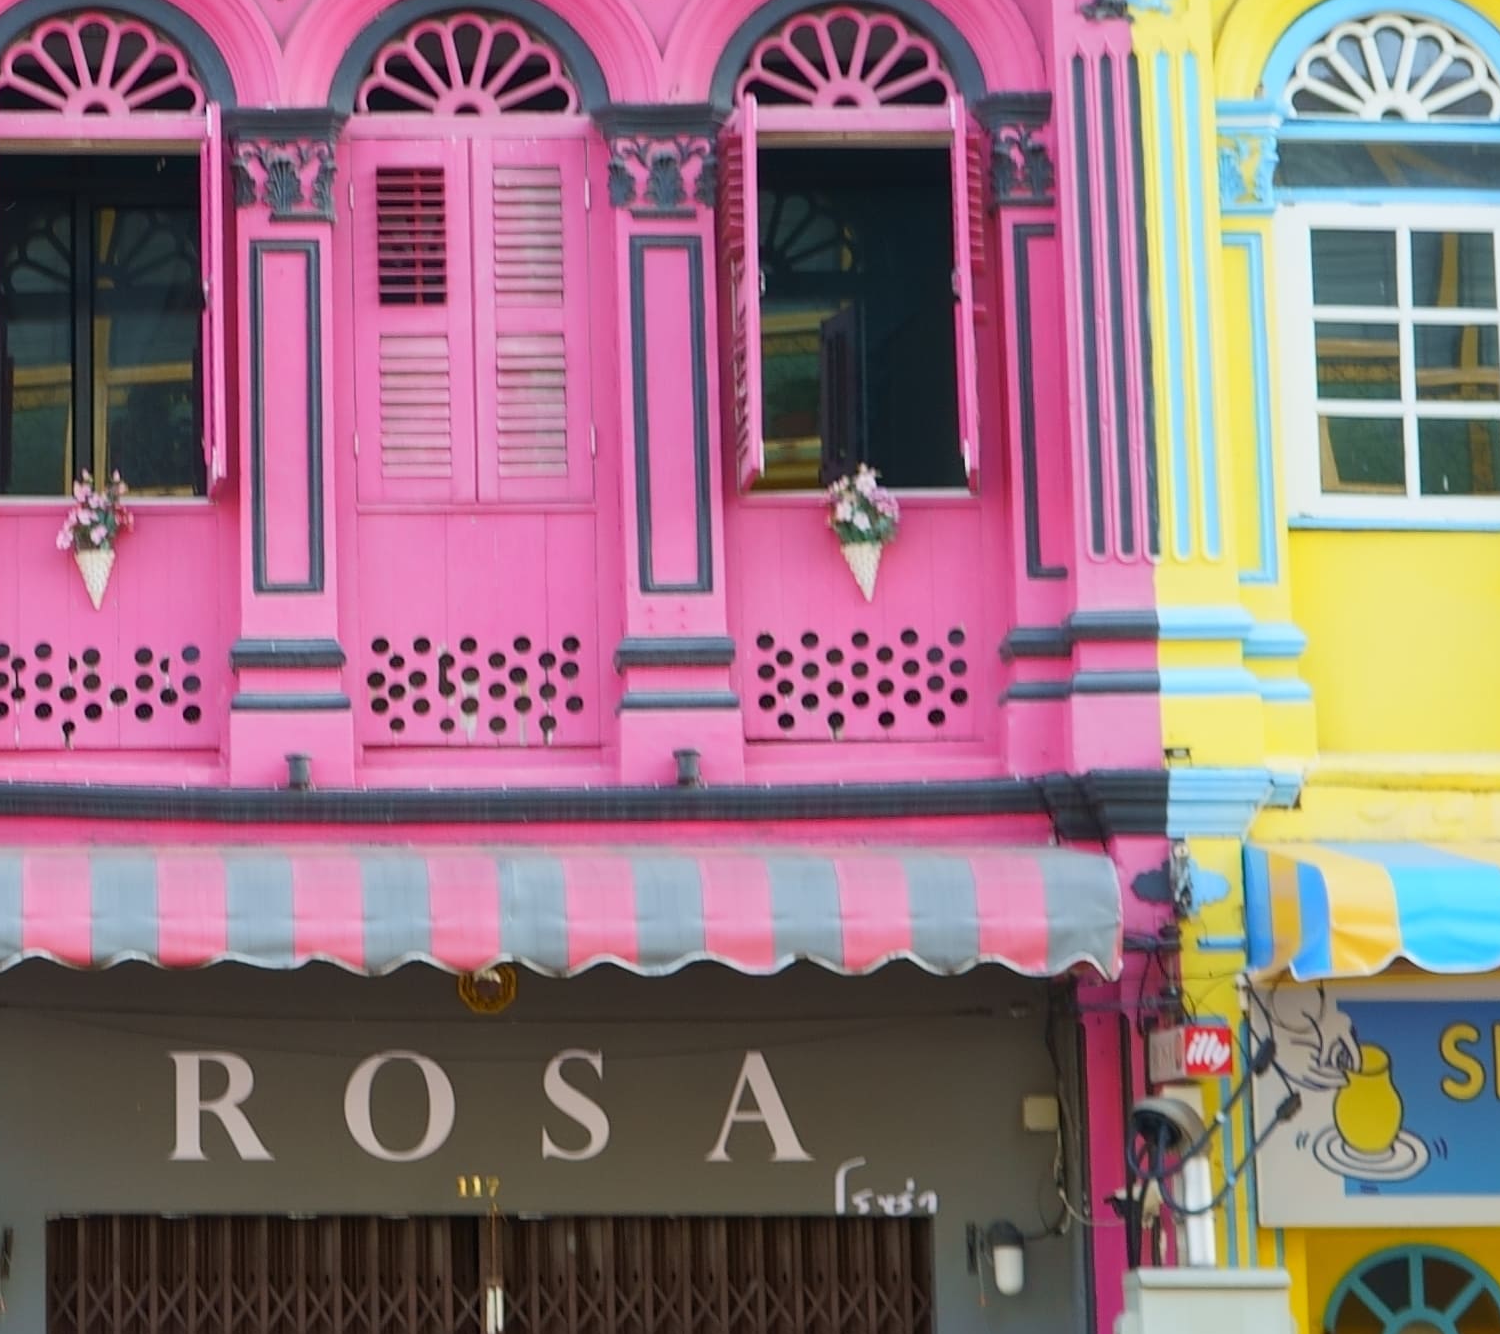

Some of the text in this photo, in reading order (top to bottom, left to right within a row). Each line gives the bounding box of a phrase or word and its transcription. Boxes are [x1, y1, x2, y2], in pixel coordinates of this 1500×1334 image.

[1186, 1030, 1230, 1072] illy
[168, 1048, 814, 1163] ROSA
[456, 1175, 501, 1198] 117
[835, 1156, 938, 1217] โรซ่า
